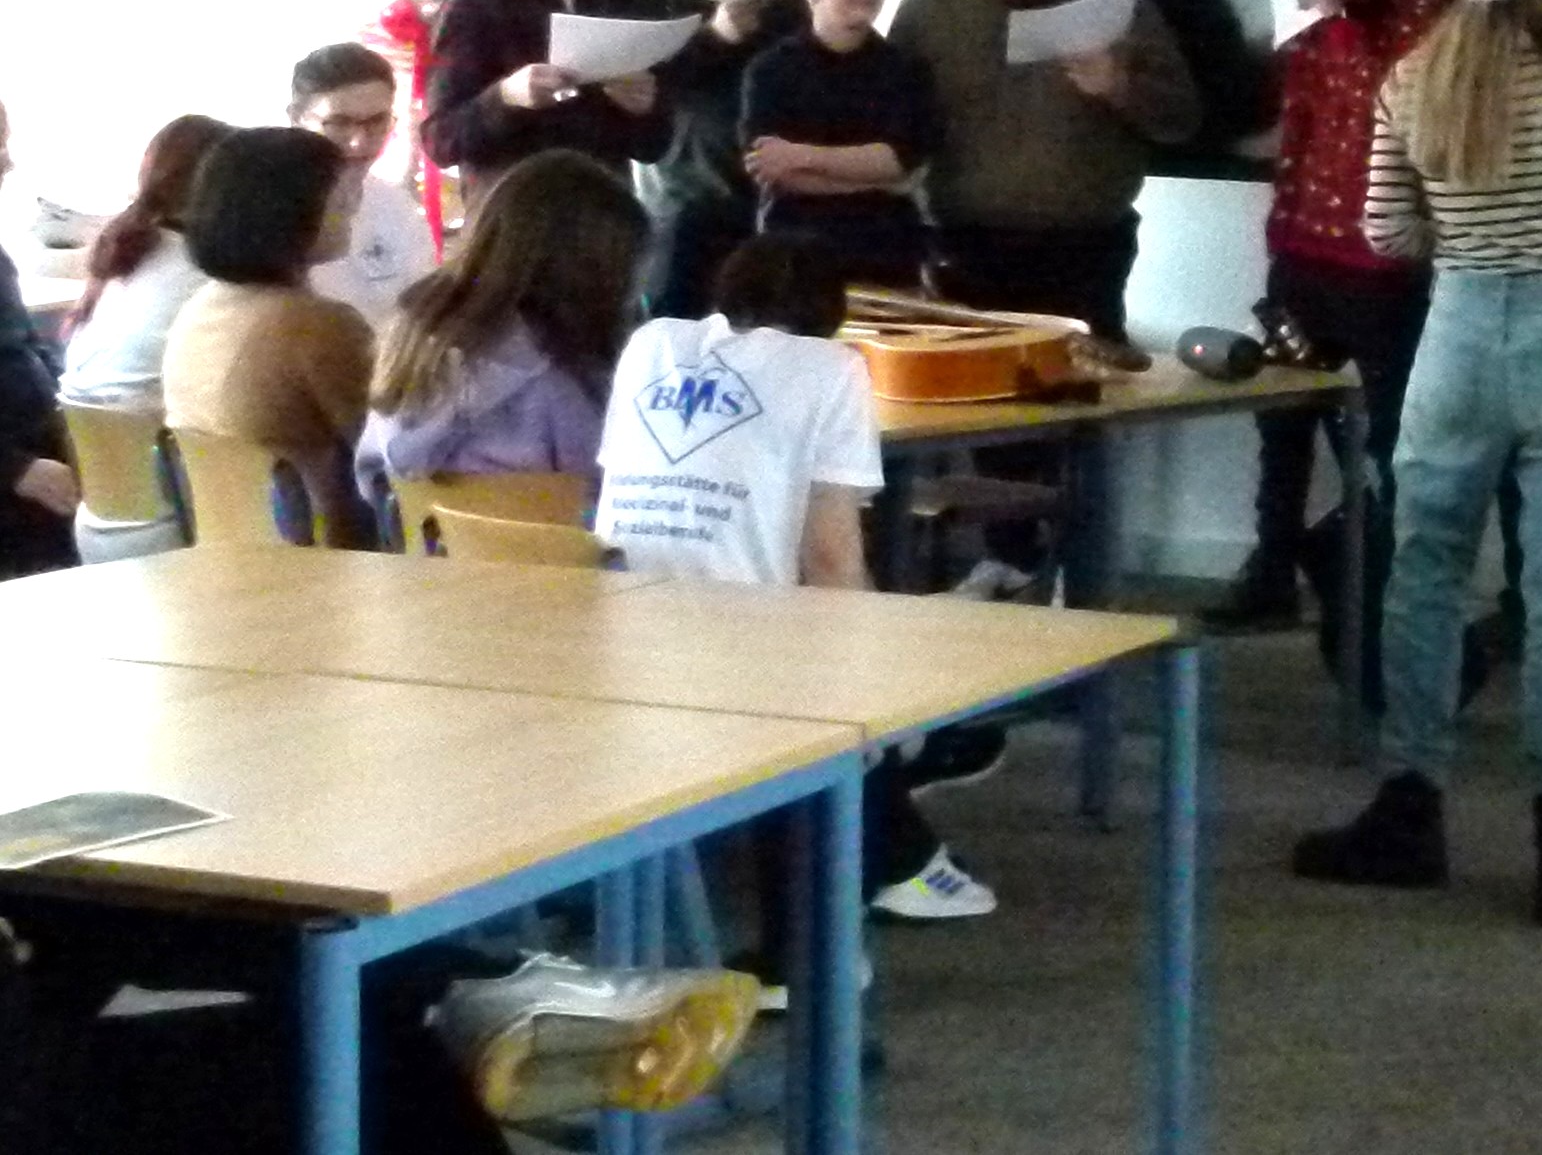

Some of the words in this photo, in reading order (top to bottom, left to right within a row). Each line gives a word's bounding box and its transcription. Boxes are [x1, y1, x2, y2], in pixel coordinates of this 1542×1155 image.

[650, 377, 746, 430] BMS
[723, 481, 750, 501] für
[695, 504, 731, 521] und
